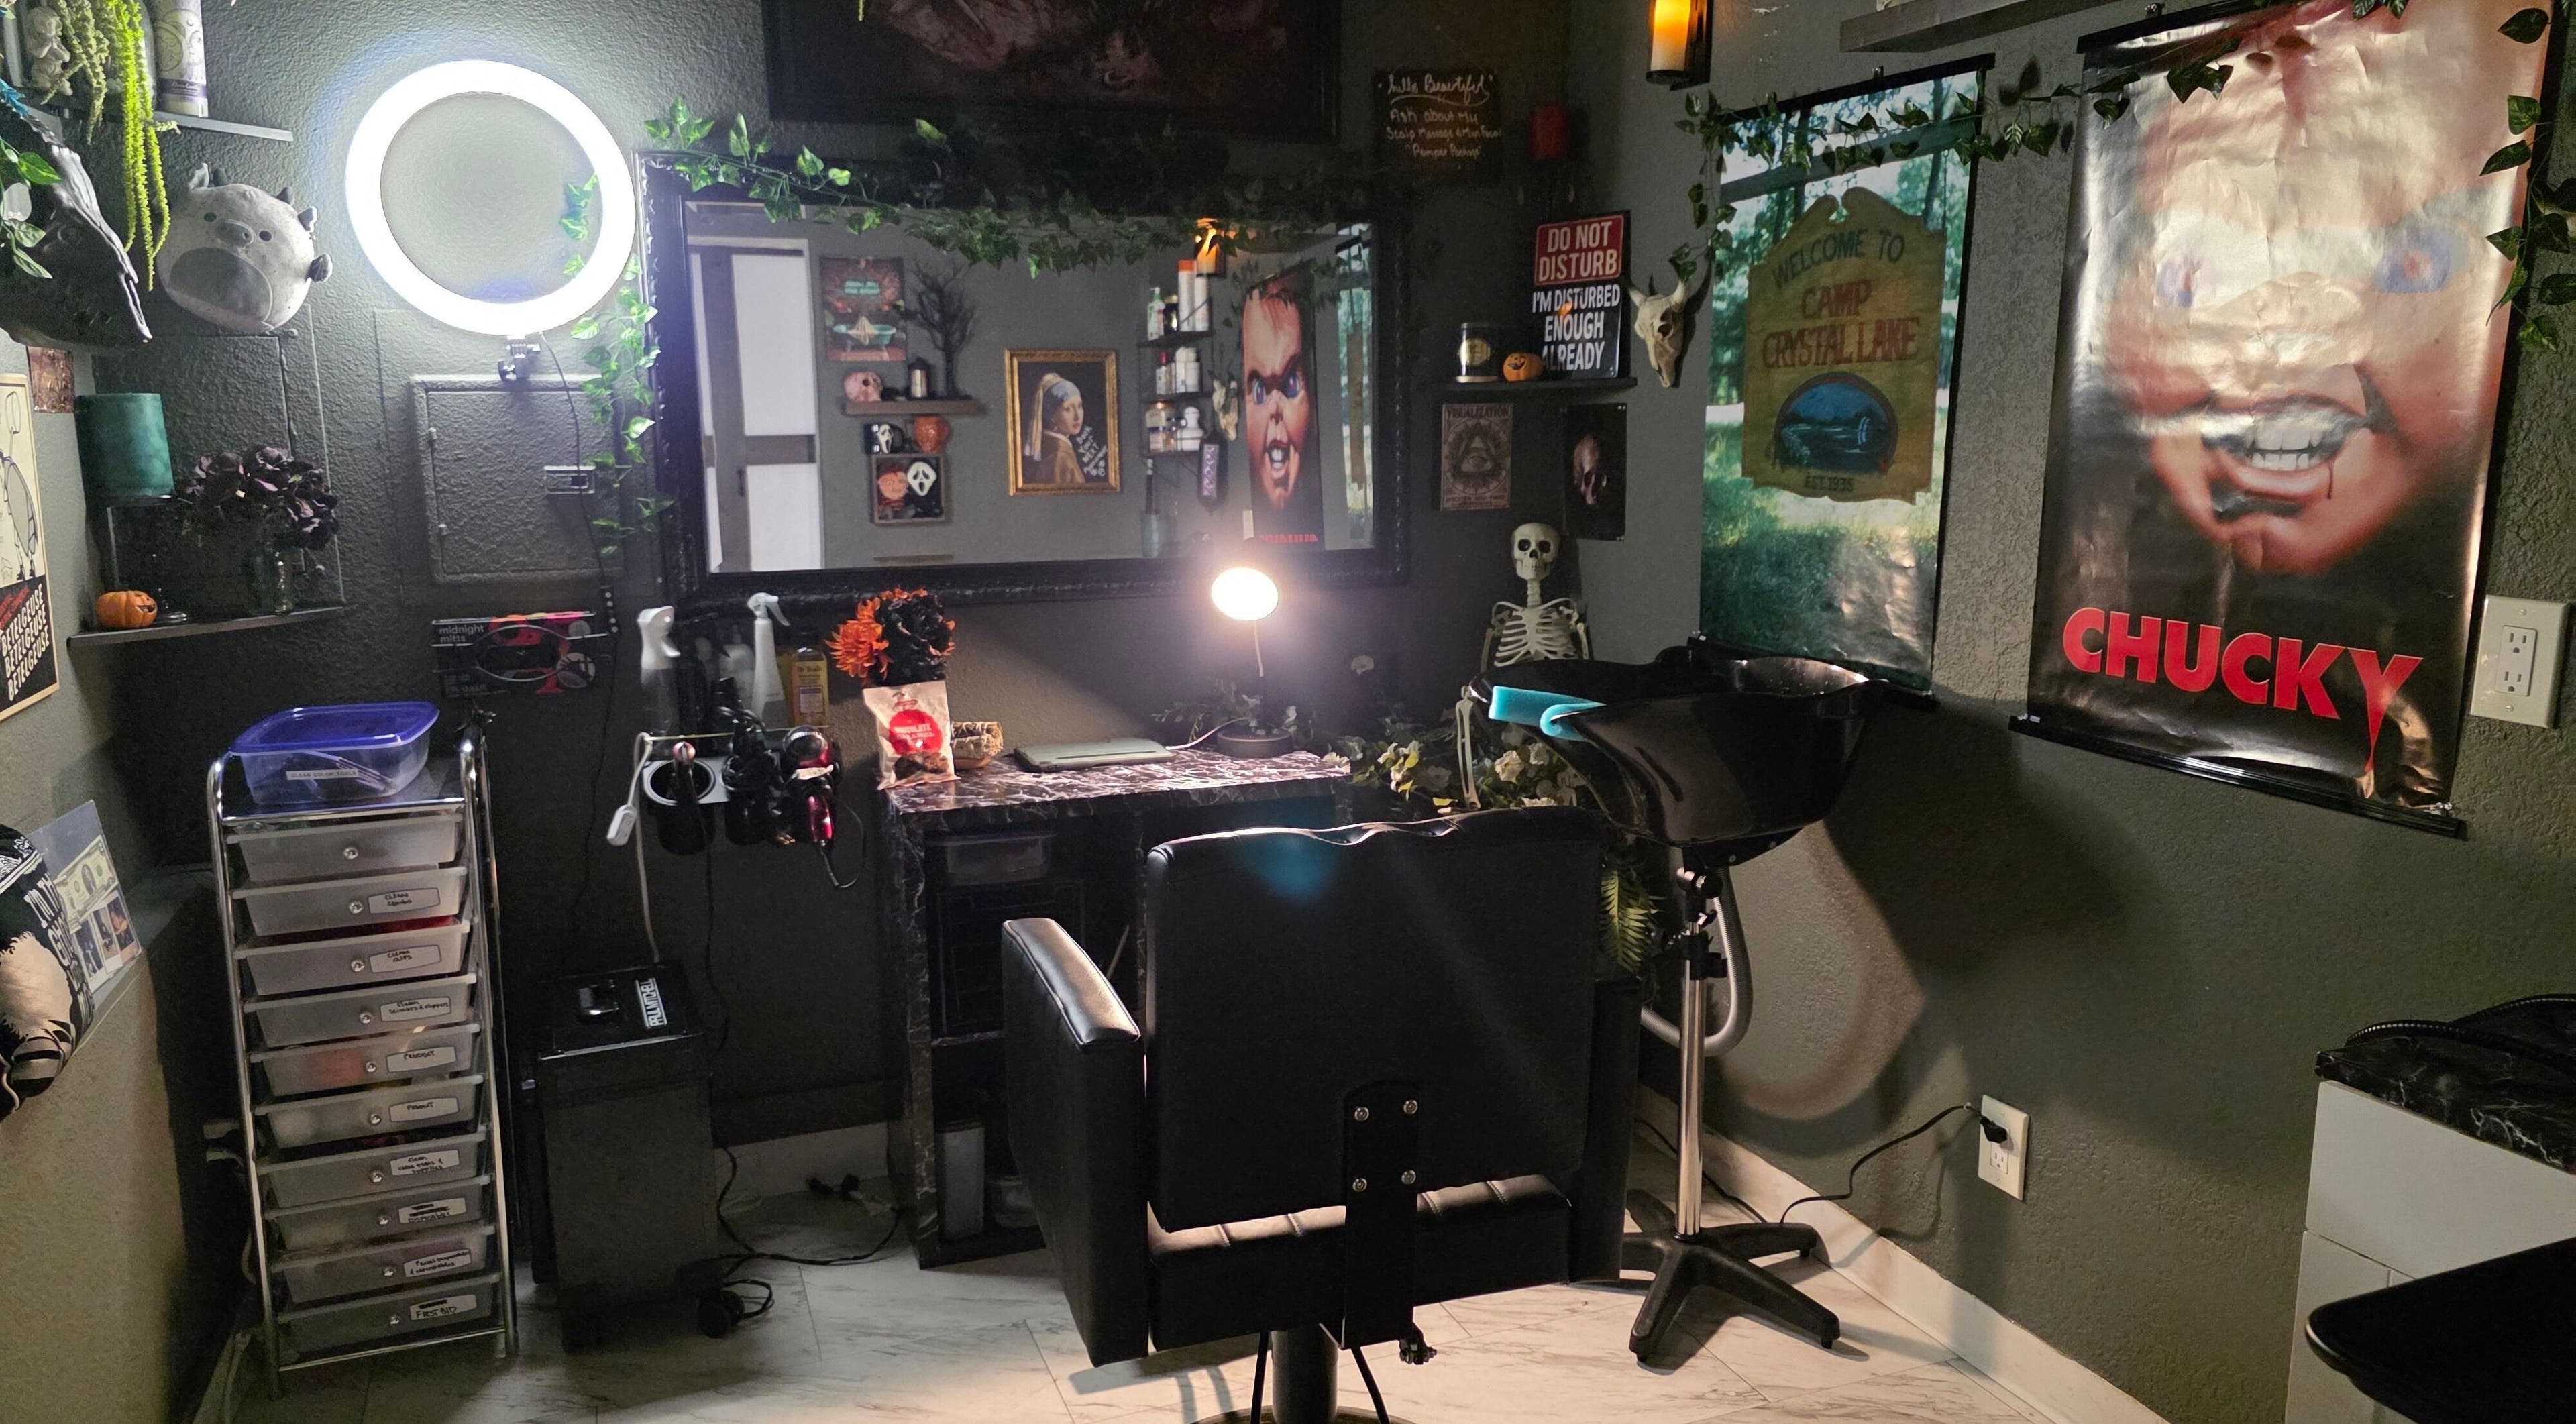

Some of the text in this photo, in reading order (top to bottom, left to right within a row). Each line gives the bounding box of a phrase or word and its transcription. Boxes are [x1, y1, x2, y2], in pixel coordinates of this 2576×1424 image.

[1423, 107, 1454, 123] about
[1547, 221, 1613, 253] DO NOT
[1539, 249, 1618, 282] DISTURB
[1771, 228, 1905, 290] WELCOME TO
[1532, 284, 1621, 314] I'M DISTURBED
[1802, 278, 1872, 319] CAMP
[1544, 311, 1605, 343] ENOUGH
[1762, 317, 1920, 369] CRYSTAL LAKE
[1542, 341, 1605, 371] ALREADY
[1, 583, 44, 657] BETELGEUSE
[439, 624, 484, 635] midnight
[5, 603, 47, 679] BETELGEUSE
[440, 635, 466, 643] mitts
[8, 625, 50, 702] BETELGEUSE
[2063, 606, 2423, 768] CHUCKY
